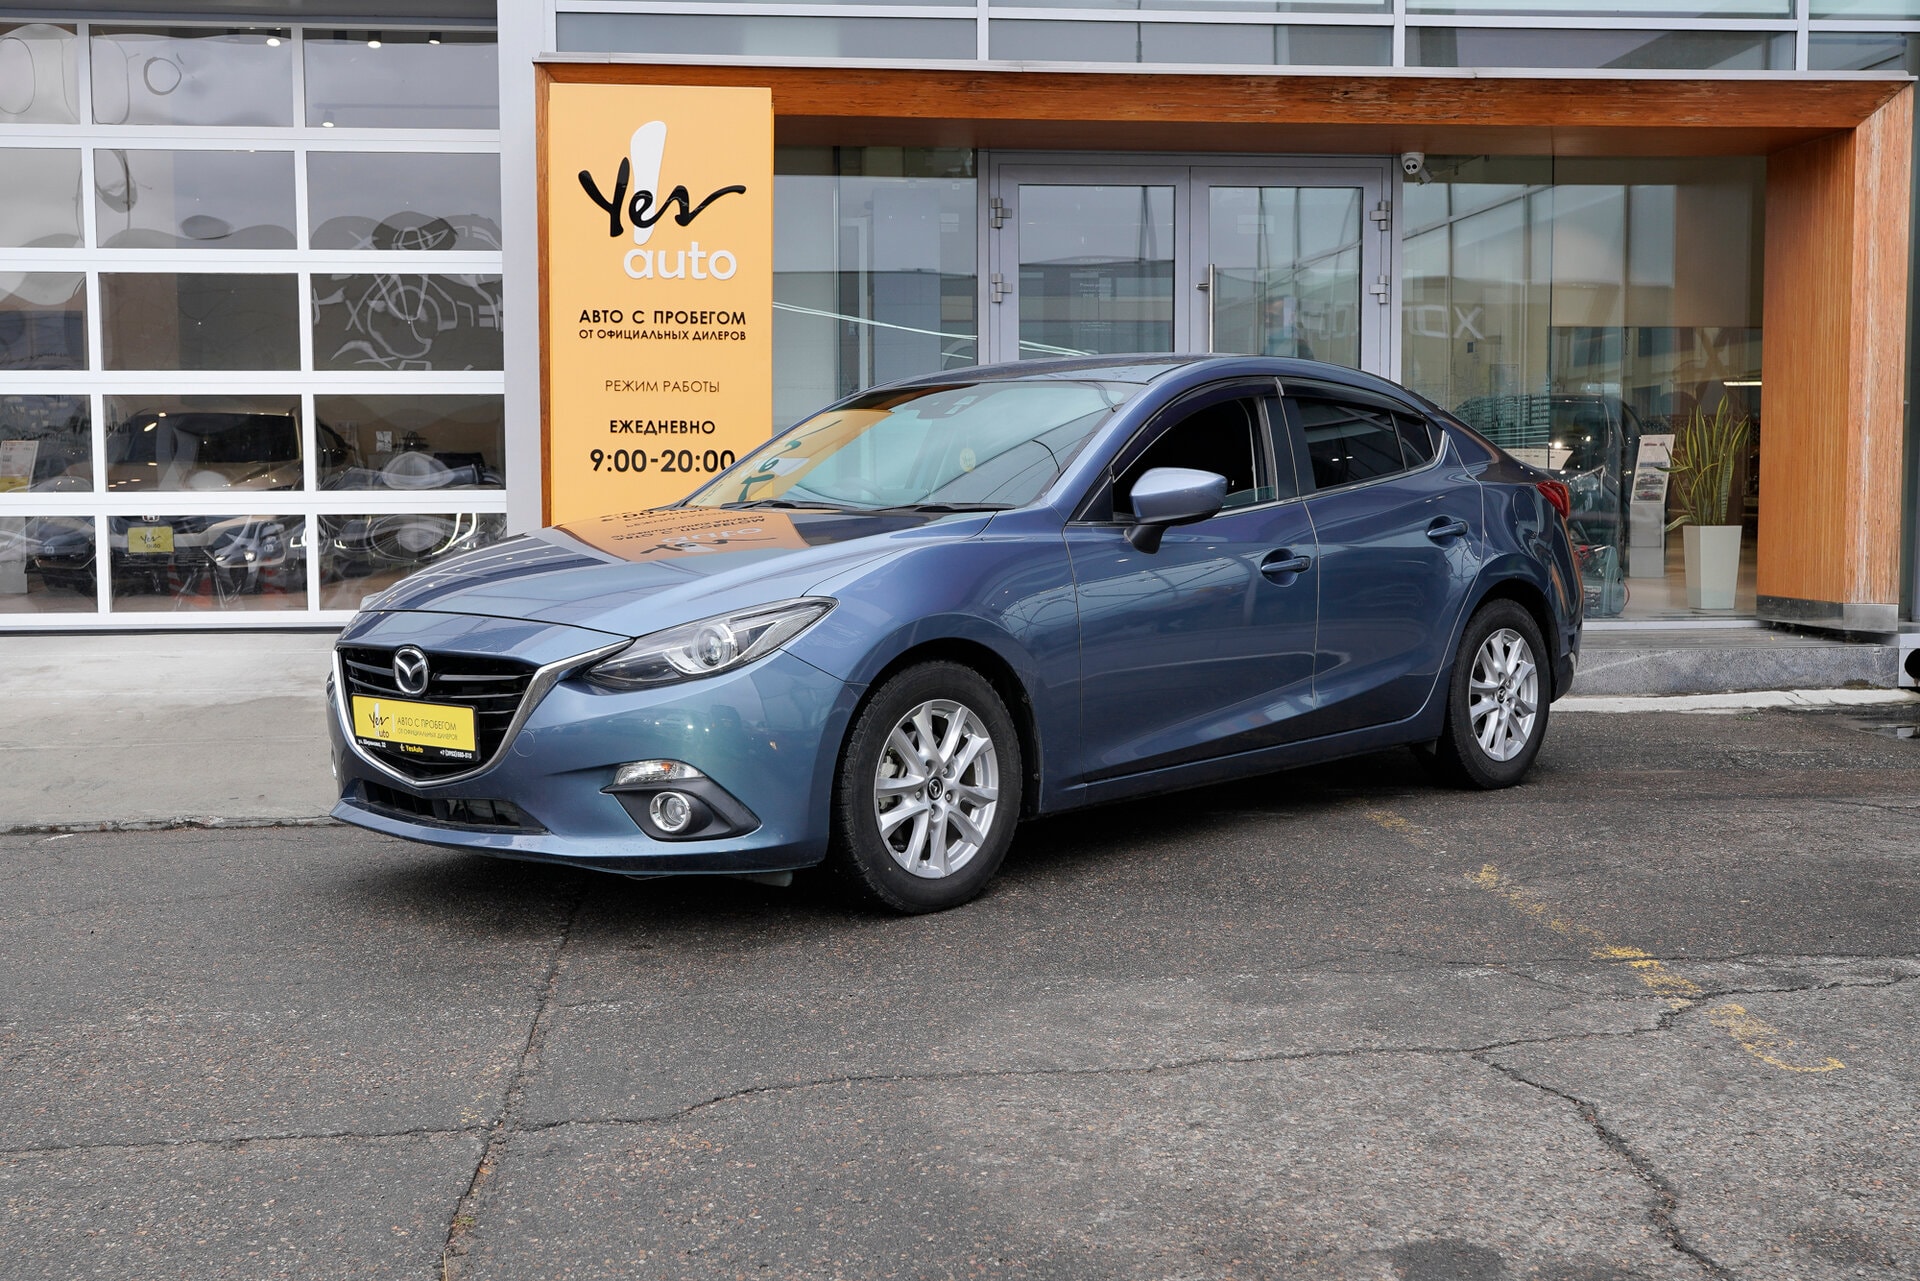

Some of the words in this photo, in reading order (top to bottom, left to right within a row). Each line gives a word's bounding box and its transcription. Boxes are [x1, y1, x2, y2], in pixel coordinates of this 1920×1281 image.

[578, 156, 747, 238] Yes
[623, 241, 737, 281] auto
[578, 309, 624, 324] АВТО
[632, 310, 645, 325] С
[653, 310, 746, 325] ПРОБЕГОМ
[578, 329, 594, 339] ОТ
[597, 329, 689, 341] ОФИЦИАЛЬНЫХ
[692, 330, 746, 342] ДИЛЕРОВ
[605, 379, 659, 392] РЕЖИМ
[663, 380, 720, 393] РАБОТЫ
[609, 419, 716, 436] ЕЖЕДНЕВНО
[590, 448, 736, 473] 9:00-20:00
[397, 716, 413, 727] АВТО
[420, 719, 457, 731] ПРОБЕГОМ
